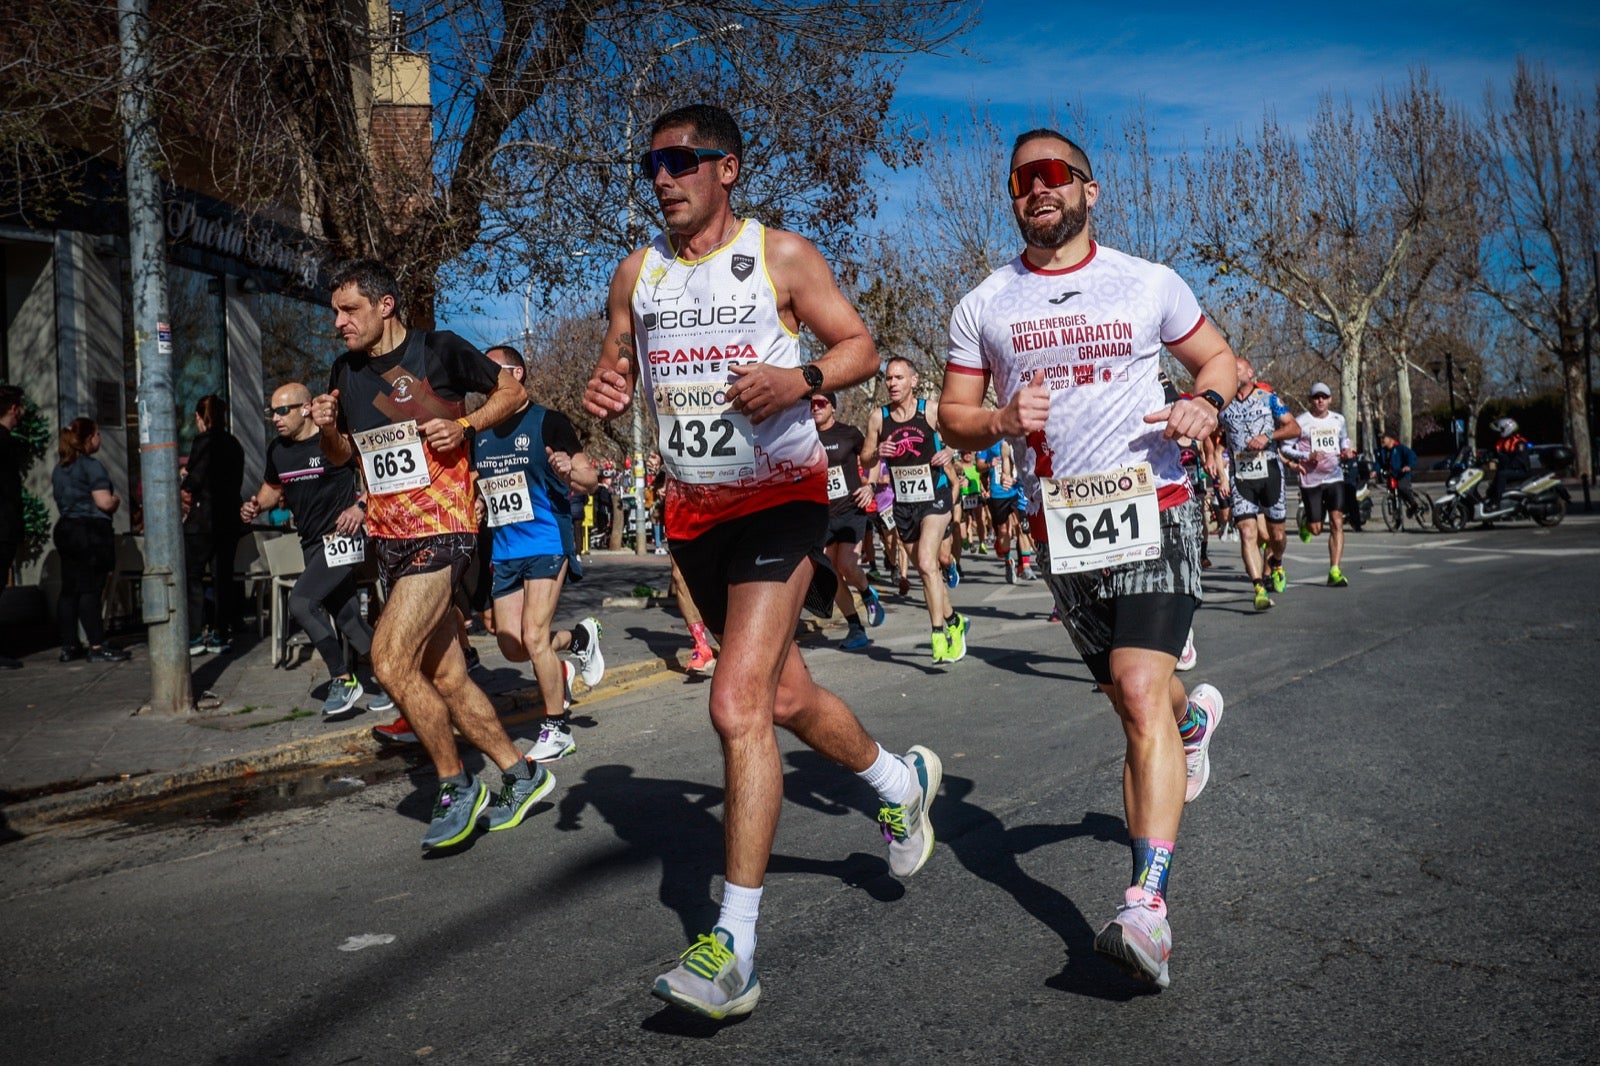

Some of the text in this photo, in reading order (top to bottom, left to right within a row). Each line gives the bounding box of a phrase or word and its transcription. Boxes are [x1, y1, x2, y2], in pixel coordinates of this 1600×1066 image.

[1010, 314, 1087, 335] TOTALENERGIES
[1011, 319, 1133, 354] MEDIA MARATÓN
[648, 344, 759, 365] GRANADA
[1078, 342, 1132, 361] GRANADA
[1051, 379, 1070, 391] 2023
[667, 391, 725, 407] FONDO
[369, 429, 405, 446] FONDO
[668, 418, 737, 458] 432
[1316, 437, 1335, 447] 166
[373, 448, 416, 479] 663
[1240, 461, 1263, 473] 234
[900, 479, 928, 494] 874
[1067, 476, 1133, 499] FONDO
[490, 492, 523, 515] 849
[1065, 502, 1140, 549] 641
[327, 537, 363, 556] 3012
